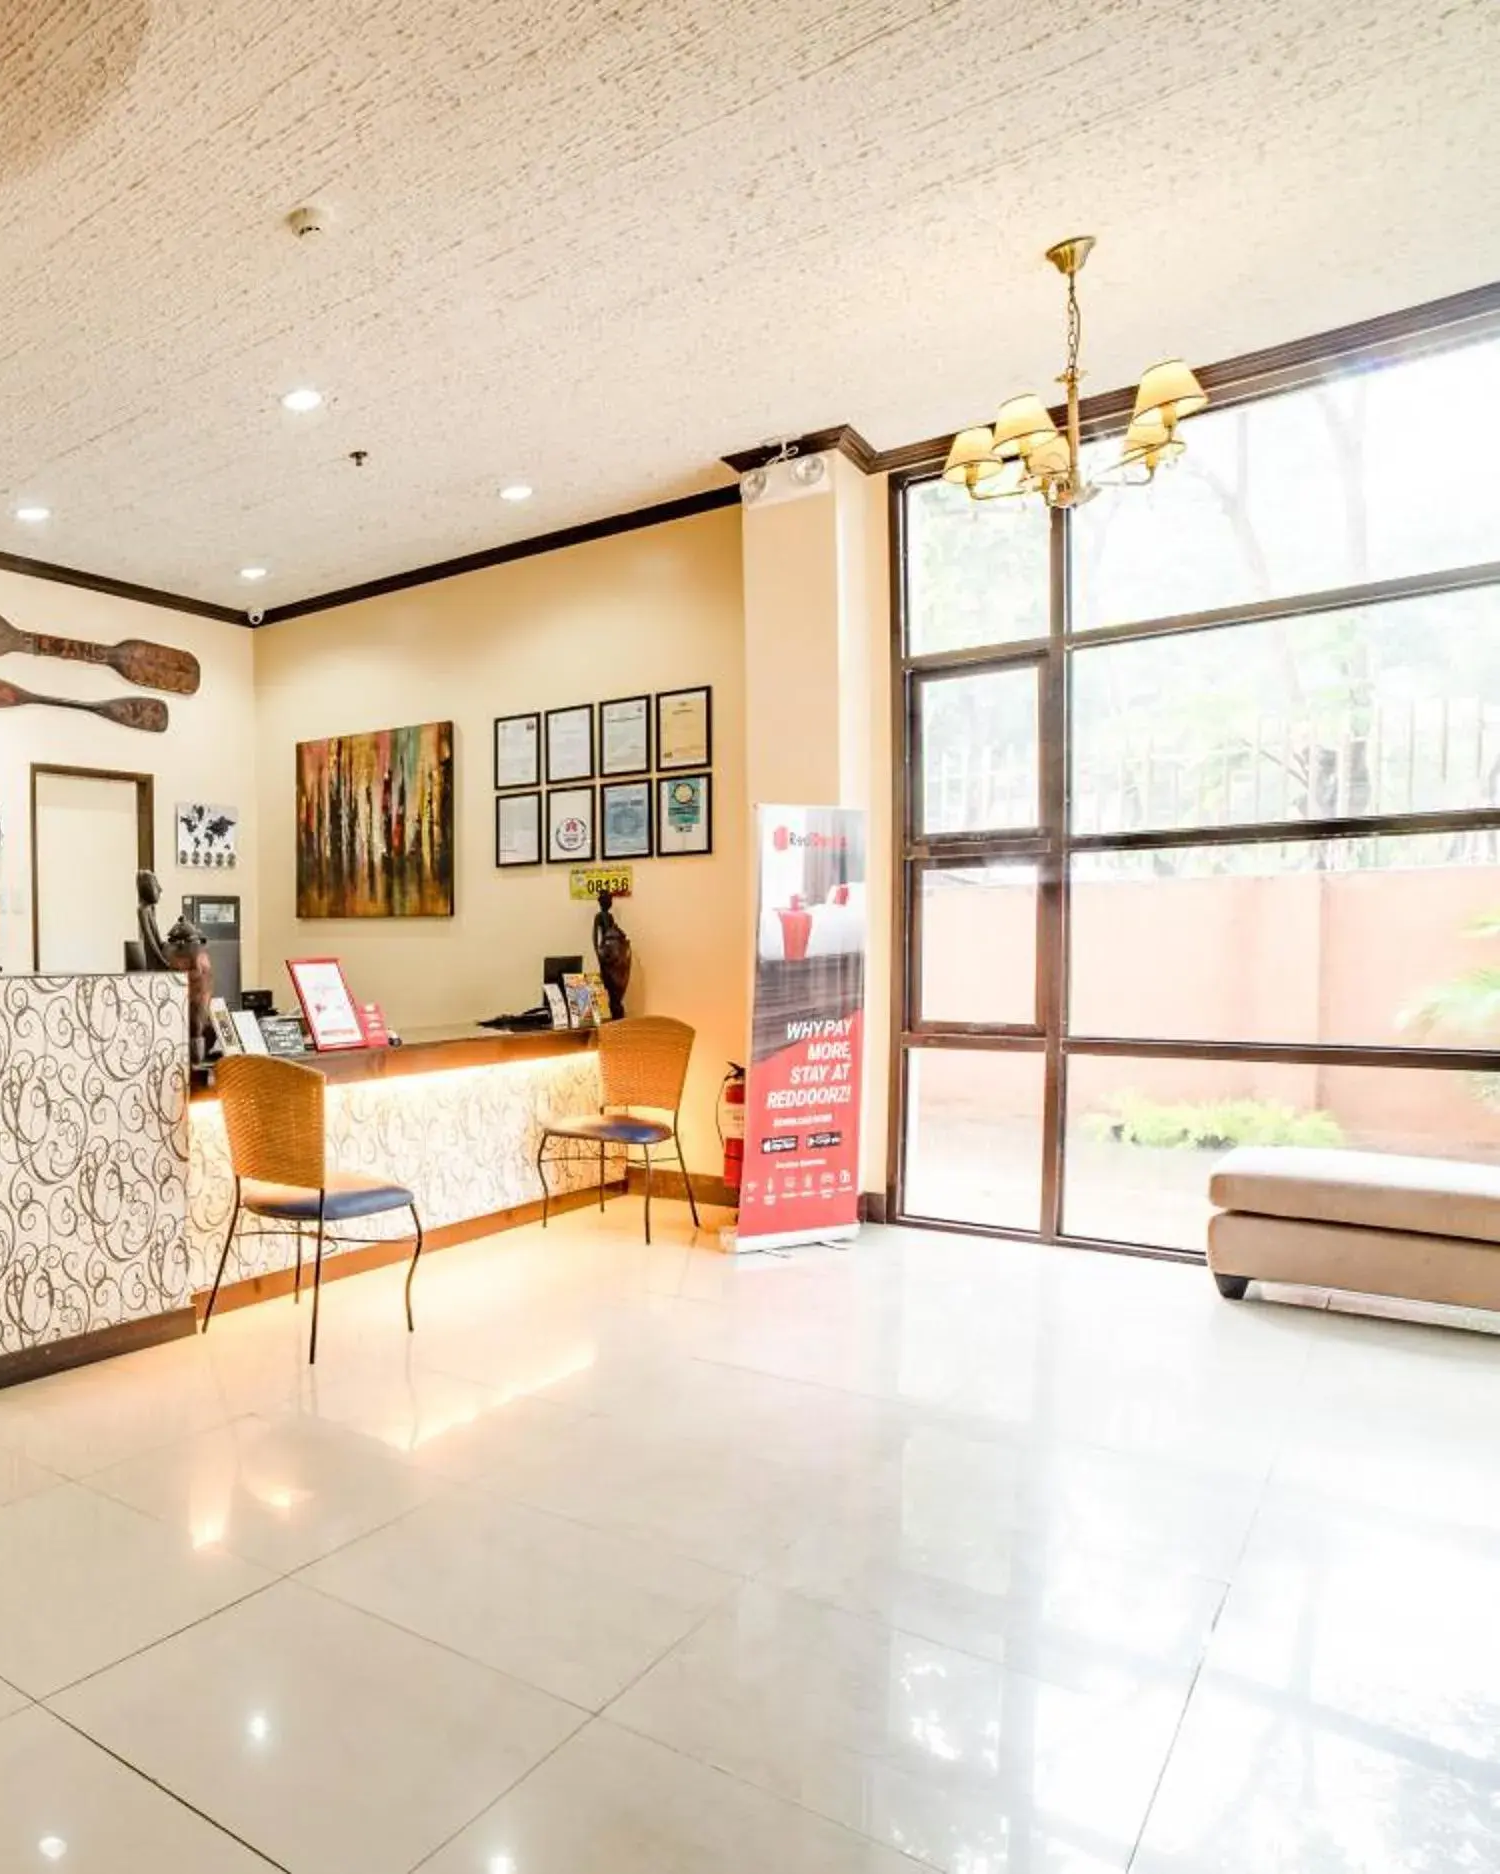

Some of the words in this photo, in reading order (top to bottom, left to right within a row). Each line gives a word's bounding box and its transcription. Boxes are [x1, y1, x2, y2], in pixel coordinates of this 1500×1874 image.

[787, 1022, 823, 1039] WHY
[824, 1018, 852, 1037] PAY
[790, 1065, 828, 1084] STAY
[831, 1063, 850, 1081] AT
